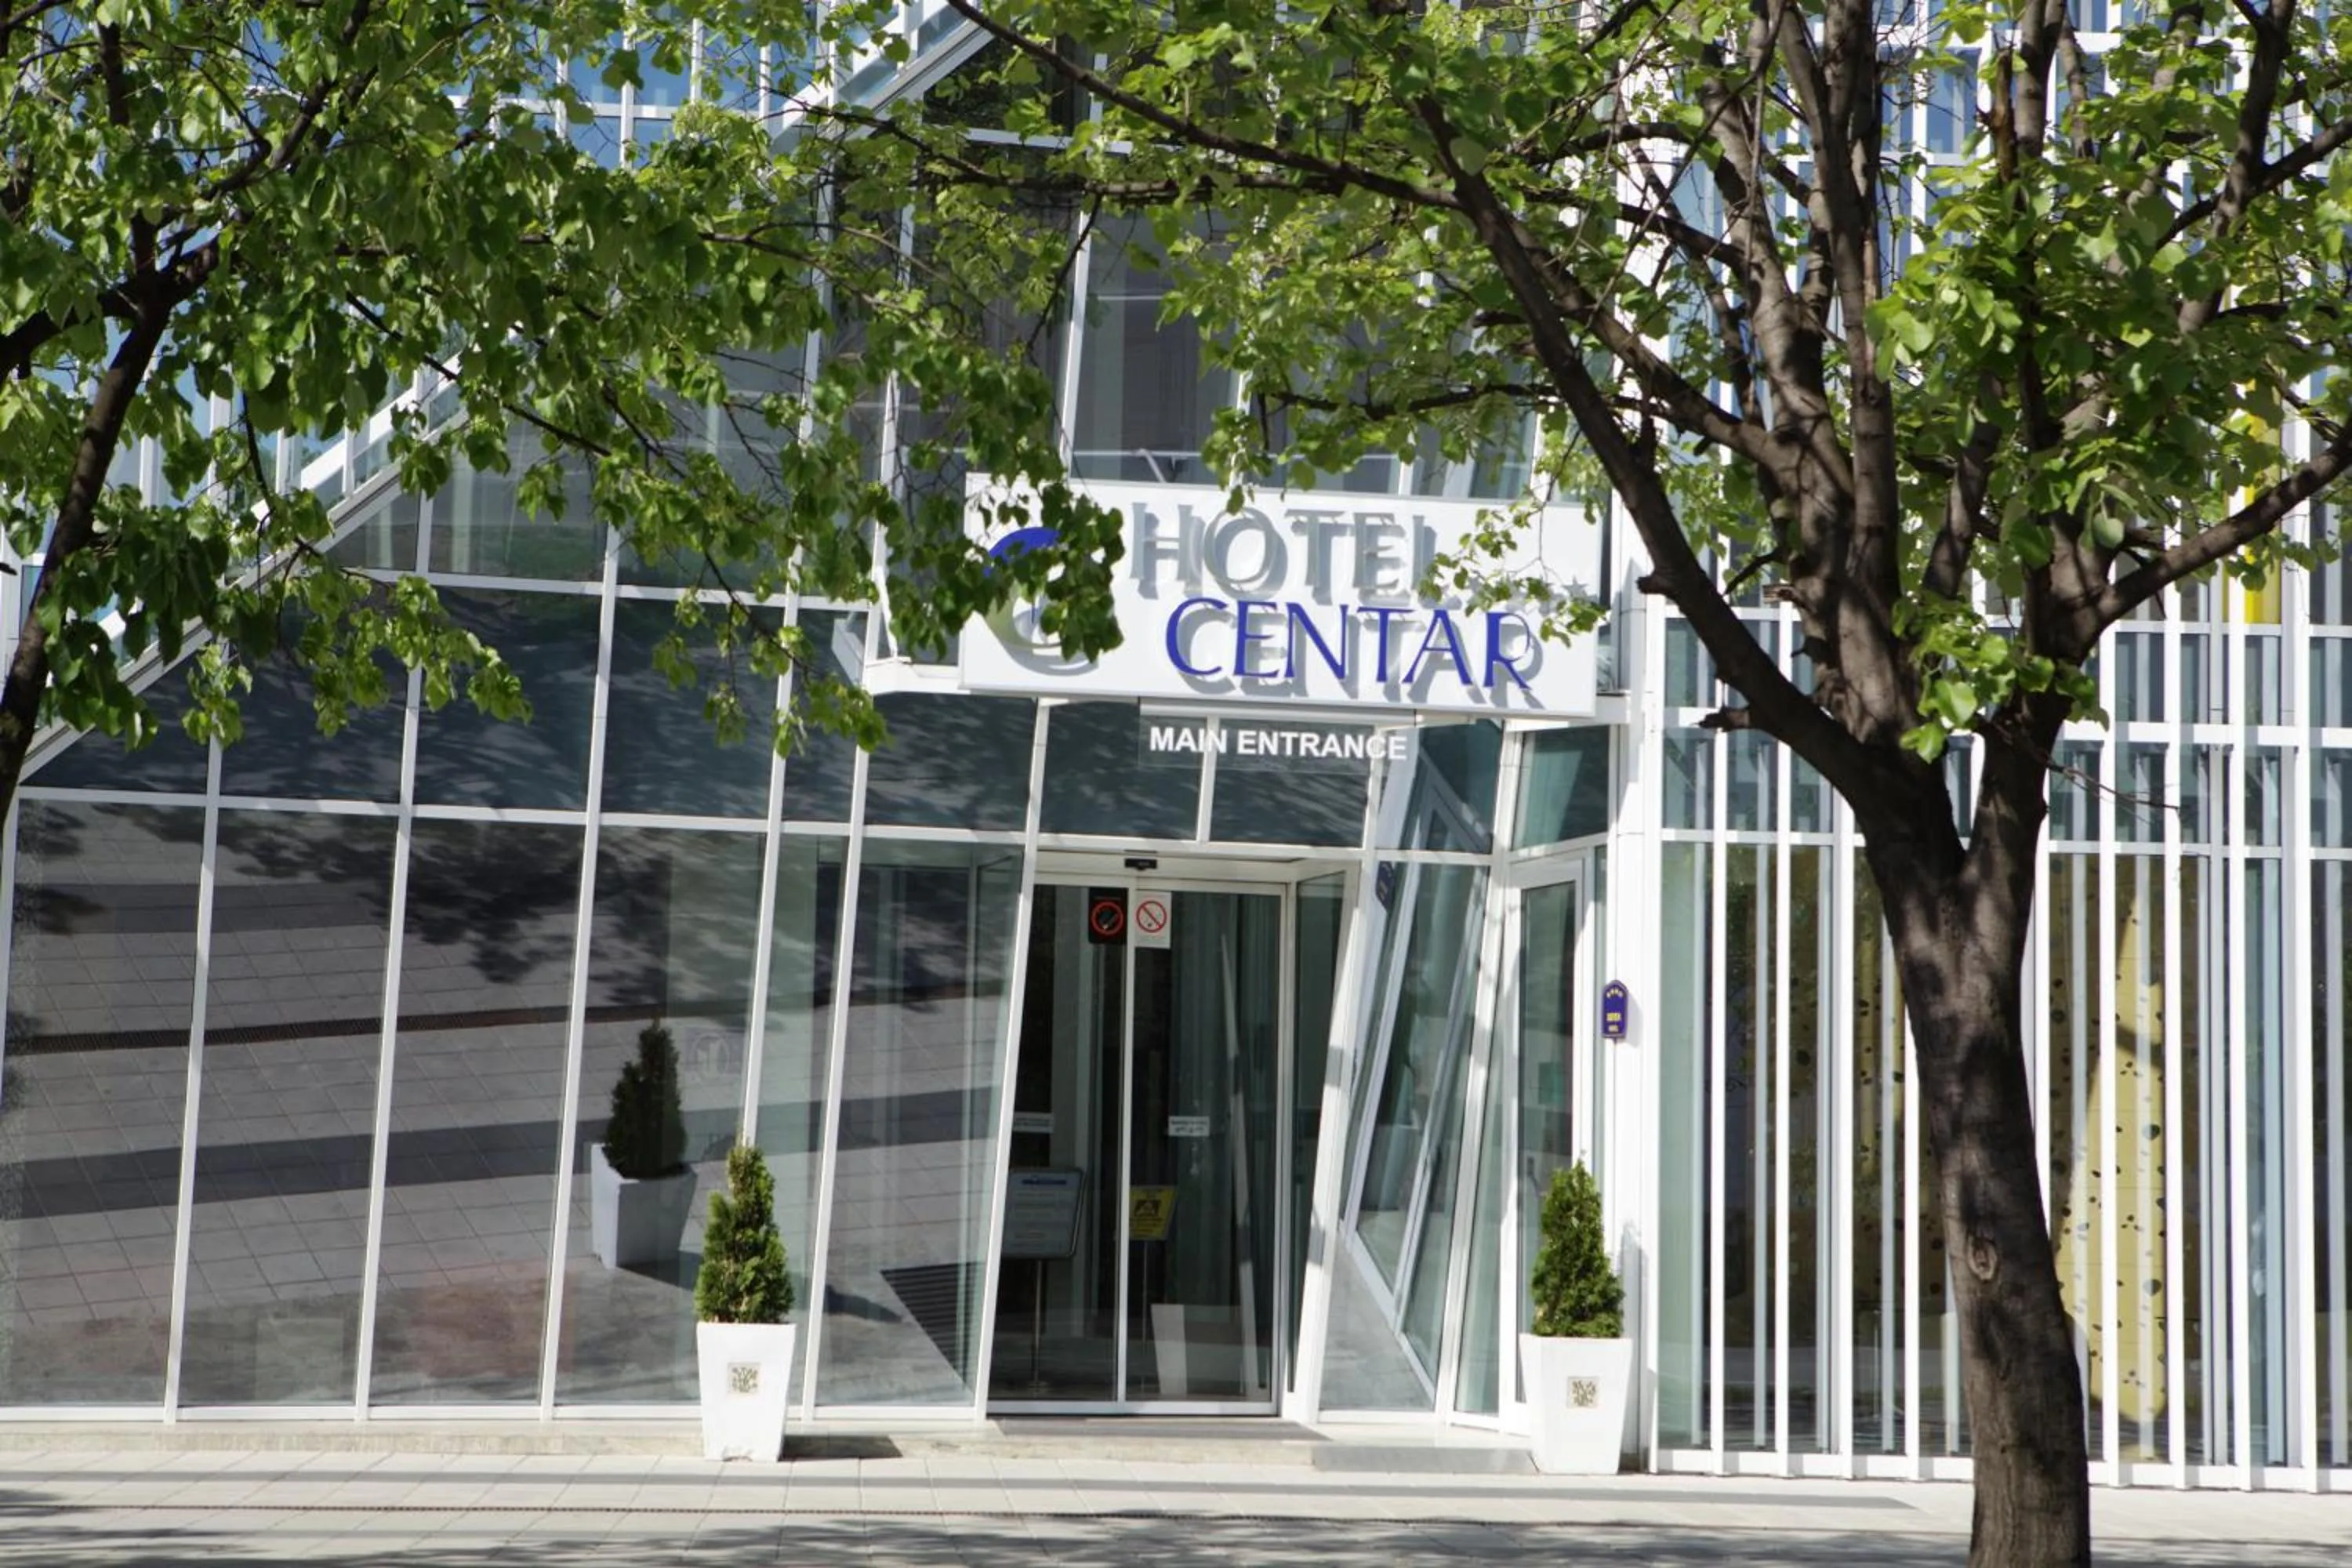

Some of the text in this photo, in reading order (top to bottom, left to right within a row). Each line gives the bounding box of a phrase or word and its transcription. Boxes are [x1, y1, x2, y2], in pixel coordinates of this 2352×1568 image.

[1130, 503, 1450, 593] HOTEL
[1166, 597, 1530, 689] CENTAR
[1149, 727, 1408, 760] MAIN ENTRANCE
